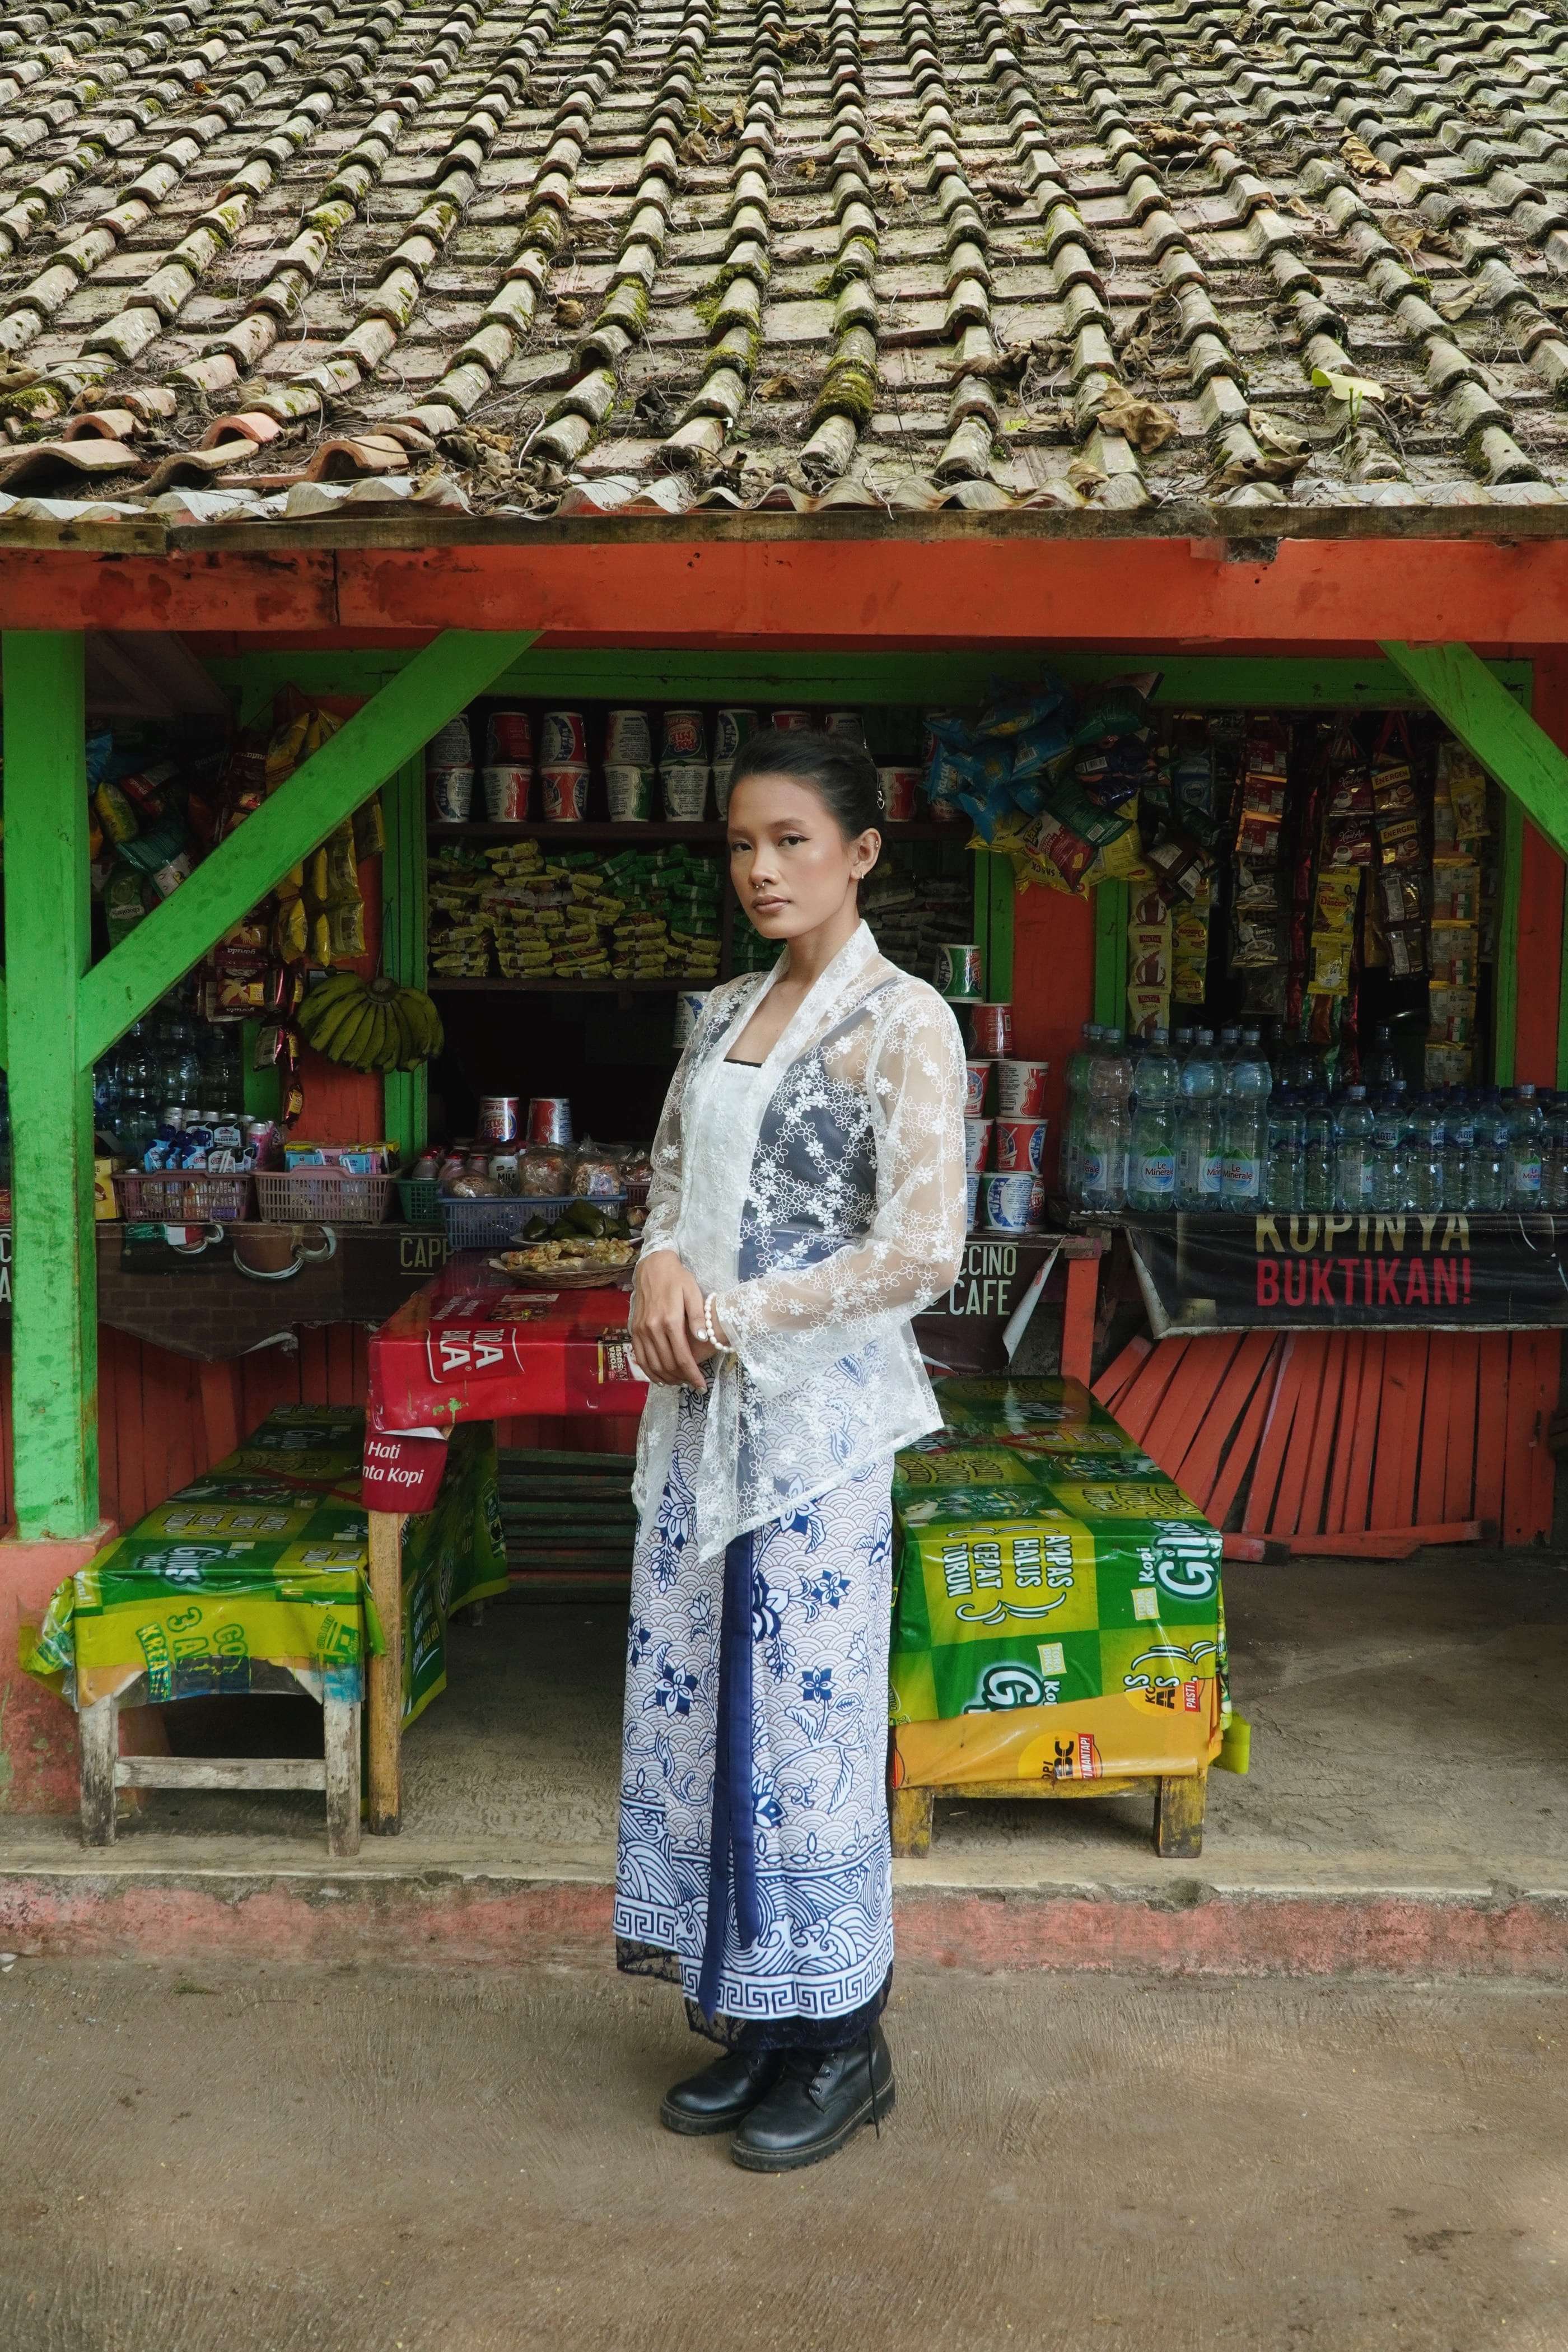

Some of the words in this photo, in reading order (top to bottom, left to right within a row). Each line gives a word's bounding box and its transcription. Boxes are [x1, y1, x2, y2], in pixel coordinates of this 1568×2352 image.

[1375, 770, 1407, 785] ENERGEN
[1383, 824, 1415, 839] ENERGEN
[1032, 862, 1056, 876] SNACK
[1376, 1132, 1397, 1141] AQUA
[1222, 1170, 1253, 1179] Minerale
[1232, 1164, 1240, 1172] Le
[1256, 1213, 1470, 1252] KOPINYA
[1257, 1258, 1471, 1306] BUKTIKAN!
[949, 1280, 1012, 1315] CAFE
[439, 1329, 471, 1373] BIKA
[473, 1328, 505, 1370] TORA
[609, 1345, 617, 1370] TORA
[615, 1345, 624, 1370] SUSU
[368, 1440, 400, 1459] Hati
[363, 1466, 384, 1481] nta
[388, 1467, 424, 1488] Kopi
[1114, 1485, 1168, 1509] AROMA
[941, 1543, 973, 1597] TURUN
[972, 1542, 1003, 1590] CEPAT
[1012, 1538, 1042, 1588] HALUS
[1044, 1535, 1074, 1588] AMPAS
[1136, 1547, 1156, 1583] Kopi
[1156, 1519, 1216, 1597] Gilus
[1043, 1648, 1053, 1673] BIKA
[1054, 1645, 1063, 1672] TORA
[1080, 1737, 1092, 1771] MANTAP!
